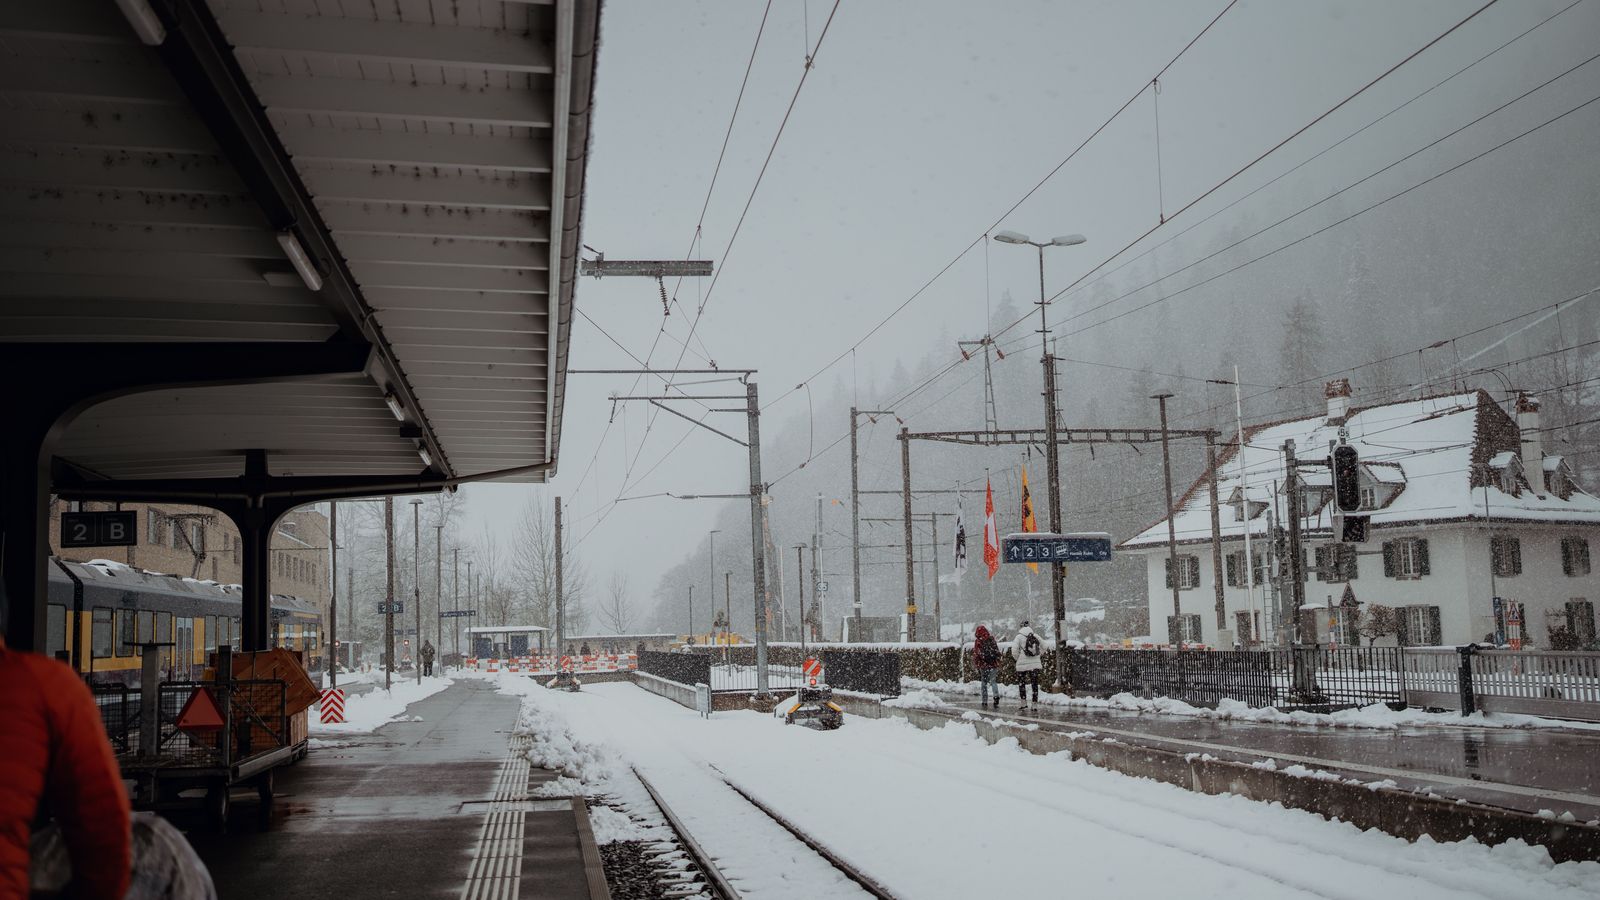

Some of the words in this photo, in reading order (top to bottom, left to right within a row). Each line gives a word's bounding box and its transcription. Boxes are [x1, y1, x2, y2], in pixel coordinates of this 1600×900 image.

[73, 523, 87, 541] 2
[110, 522, 125, 540] B
[1026, 547, 1033, 557] 2
[1042, 547, 1049, 557] 3
